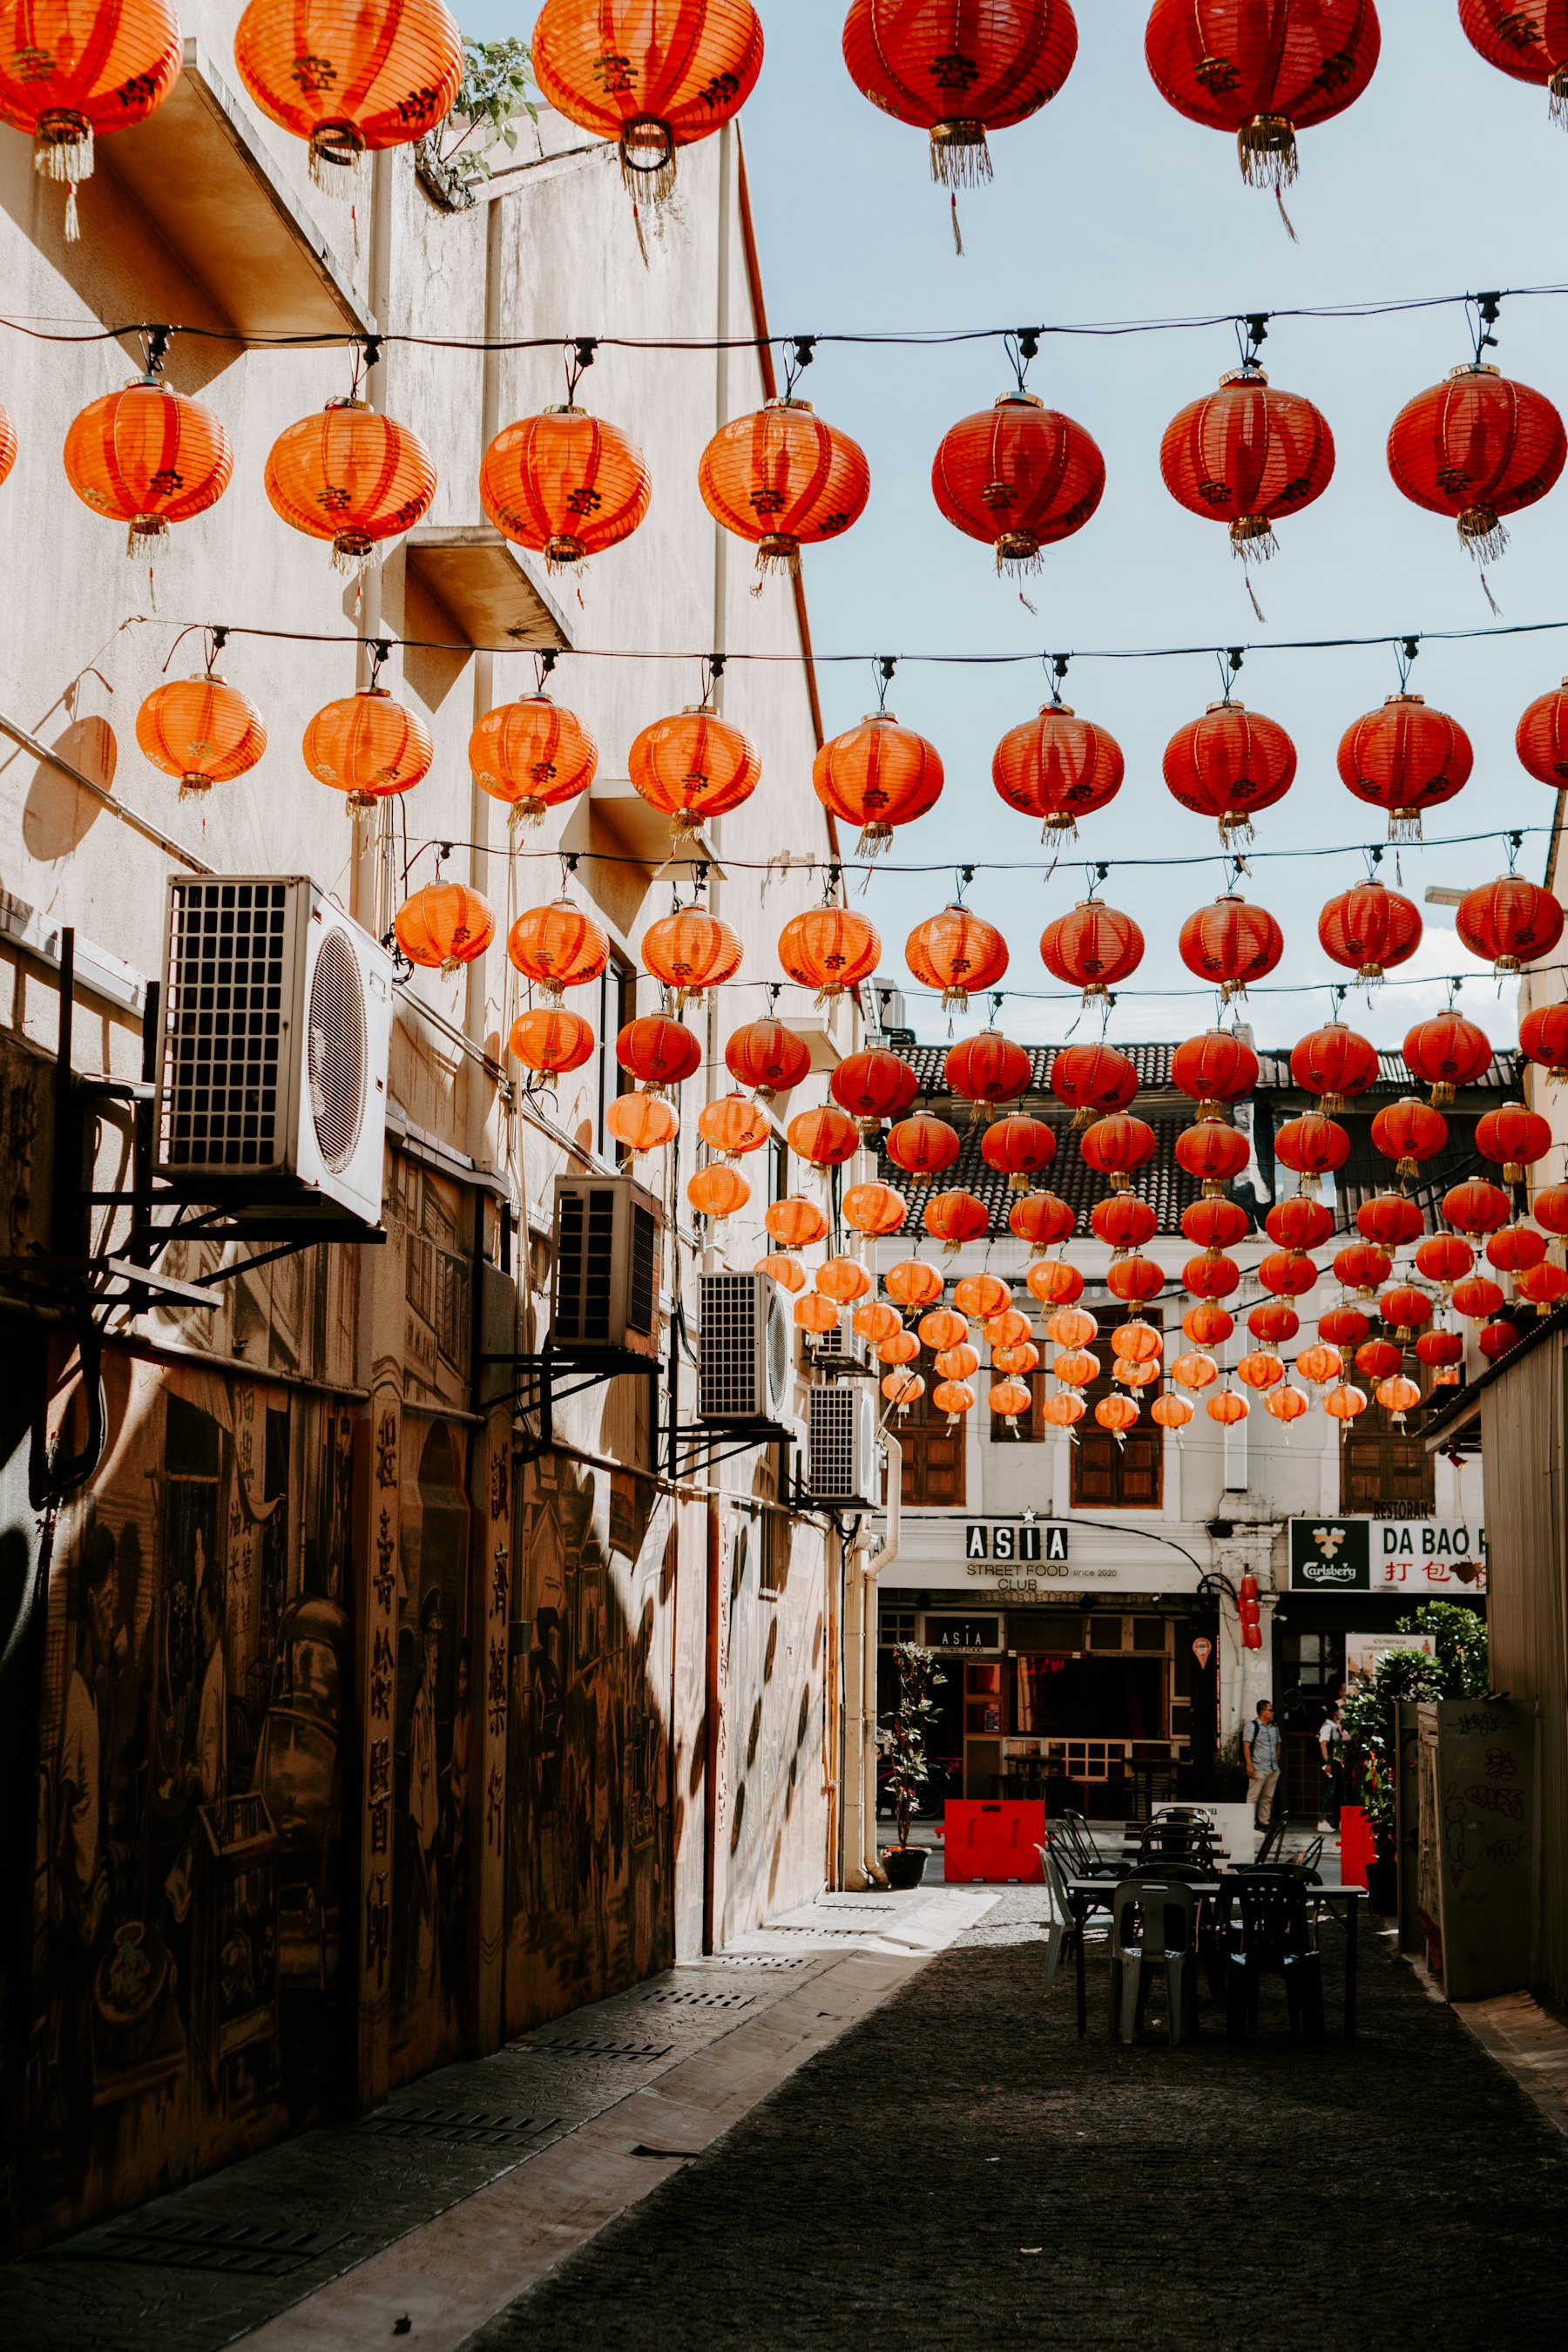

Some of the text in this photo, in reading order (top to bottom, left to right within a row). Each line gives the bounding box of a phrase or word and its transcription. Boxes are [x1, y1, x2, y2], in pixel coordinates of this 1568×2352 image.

[1373, 1500, 1429, 1520] RESTORAN
[968, 1526, 1066, 1559] ASIA
[1383, 1527, 1414, 1555] DA
[1422, 1527, 1470, 1556] BAO
[967, 1565, 1022, 1576] STREET
[1026, 1565, 1069, 1577] FOOD
[1302, 1562, 1356, 1581] Carlsberg
[997, 1578, 1037, 1591] CLUB
[942, 1632, 982, 1646] ASIA
